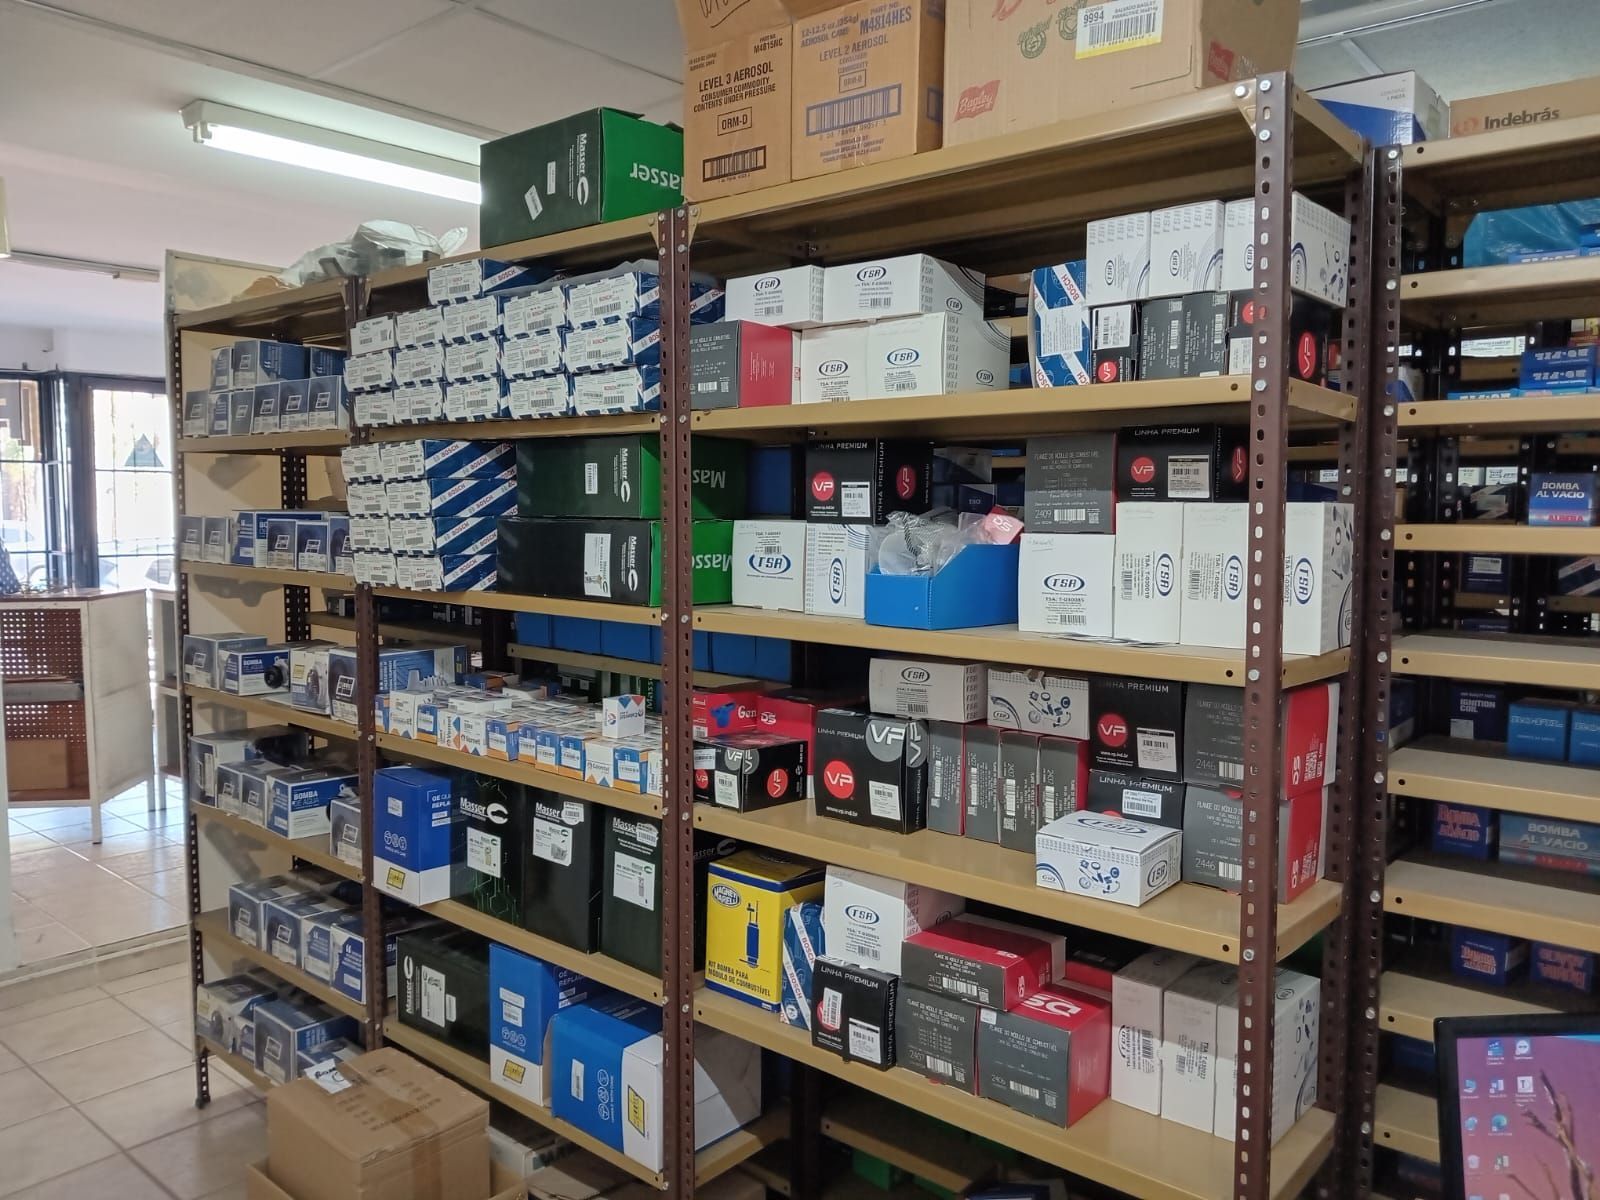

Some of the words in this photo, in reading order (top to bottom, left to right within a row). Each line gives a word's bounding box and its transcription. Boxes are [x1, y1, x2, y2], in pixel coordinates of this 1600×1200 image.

[860, 6, 912, 35] M4814HES
[1083, 10, 1104, 25] 9994
[754, 38, 783, 54] M4815NC
[820, 47, 841, 62] LEVEL
[844, 45, 850, 54] 2
[852, 34, 888, 53] AEROSOL
[699, 75, 724, 92] LEVEL
[726, 73, 731, 84] 3
[733, 61, 774, 82] AEROSOL
[694, 98, 723, 112] CONTENTS
[724, 93, 744, 105] UNDER
[744, 83, 776, 99] PRESSURE
[701, 87, 733, 103] CONSUMER
[733, 77, 770, 94] COMMODITY
[721, 114, 748, 130] ORM-D
[1484, 107, 1560, 130] Indebrás
[579, 133, 587, 175] Masser
[630, 162, 684, 198] asser
[499, 267, 517, 282] BOSCH
[1061, 274, 1079, 301] BOSCH
[1302, 336, 1312, 372] VP
[1036, 369, 1050, 388] OSCH
[1161, 427, 1200, 435] PREMIUM
[1132, 465, 1154, 475] VP
[814, 482, 834, 492] VP
[1536, 490, 1549, 498] AL
[1542, 482, 1579, 490] BOMBA
[758, 556, 783, 568] TSA
[1128, 682, 1169, 693] PREMIUM
[1460, 699, 1496, 708] IGNITION
[1460, 705, 1479, 713] COIL
[817, 727, 835, 735] LINHA
[837, 731, 865, 740] PREMIUM
[871, 724, 905, 745] VP
[1100, 723, 1127, 737] VP
[910, 722, 921, 766] VP
[727, 750, 742, 762] VP
[826, 770, 853, 787] VP
[1099, 776, 1127, 786] LINHA
[1129, 780, 1173, 793] PREMIUM
[293, 790, 319, 800] BOMBA
[460, 796, 486, 816] Masser
[535, 802, 560, 817] Masser
[1528, 823, 1581, 838] BOMBA
[1520, 833, 1537, 844] AL
[1542, 836, 1588, 851] VACIO
[1195, 857, 1216, 870] 2446
[717, 963, 734, 975] BOMBA
[736, 970, 748, 979] PARA
[820, 965, 842, 978] LINHA
[844, 973, 879, 989] PREMIUM
[708, 967, 728, 981] MÓDULO
[736, 978, 770, 997] COMBUSTÍVEL
[789, 972, 803, 999] BOSCH
[405, 979, 413, 1015] Masser
